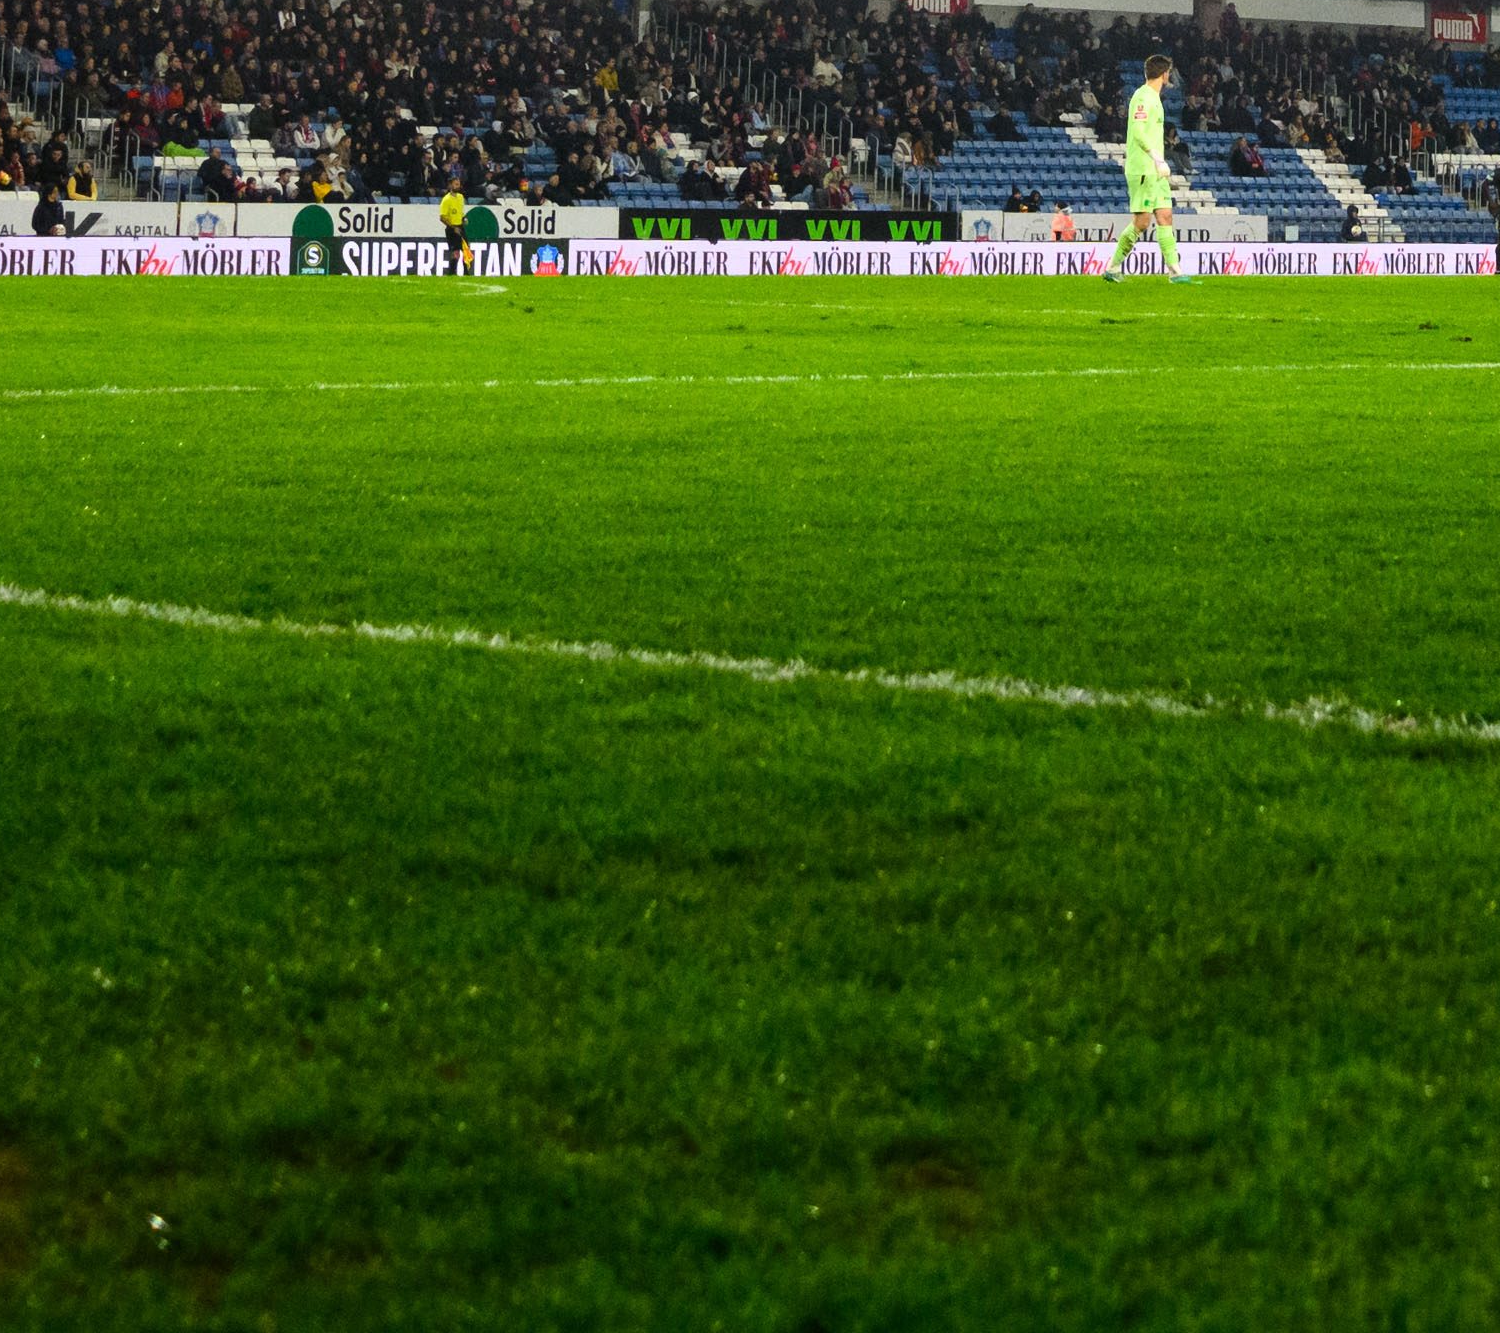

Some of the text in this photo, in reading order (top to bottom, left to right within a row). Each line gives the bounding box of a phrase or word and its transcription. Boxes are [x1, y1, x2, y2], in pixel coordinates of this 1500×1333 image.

[1434, 18, 1473, 40] PUMA
[115, 224, 170, 237] KAPITAL
[338, 206, 394, 233] Solid
[504, 208, 556, 235] Solid
[100, 249, 150, 275] EKE
[182, 243, 281, 275] MÖBLER
[342, 241, 522, 275] SUPERETAN
[575, 250, 617, 275] EKE
[645, 245, 728, 275] MÖBLER
[749, 250, 787, 275] EKE
[813, 246, 891, 275] MÖBLER
[910, 251, 941, 275] EKE
[971, 246, 1044, 275] MÖBLER
[1198, 252, 1226, 275] EKE
[1253, 247, 1317, 275] MÖBLER
[1332, 252, 1359, 274] EKE
[1384, 248, 1445, 274] MÖBLER
